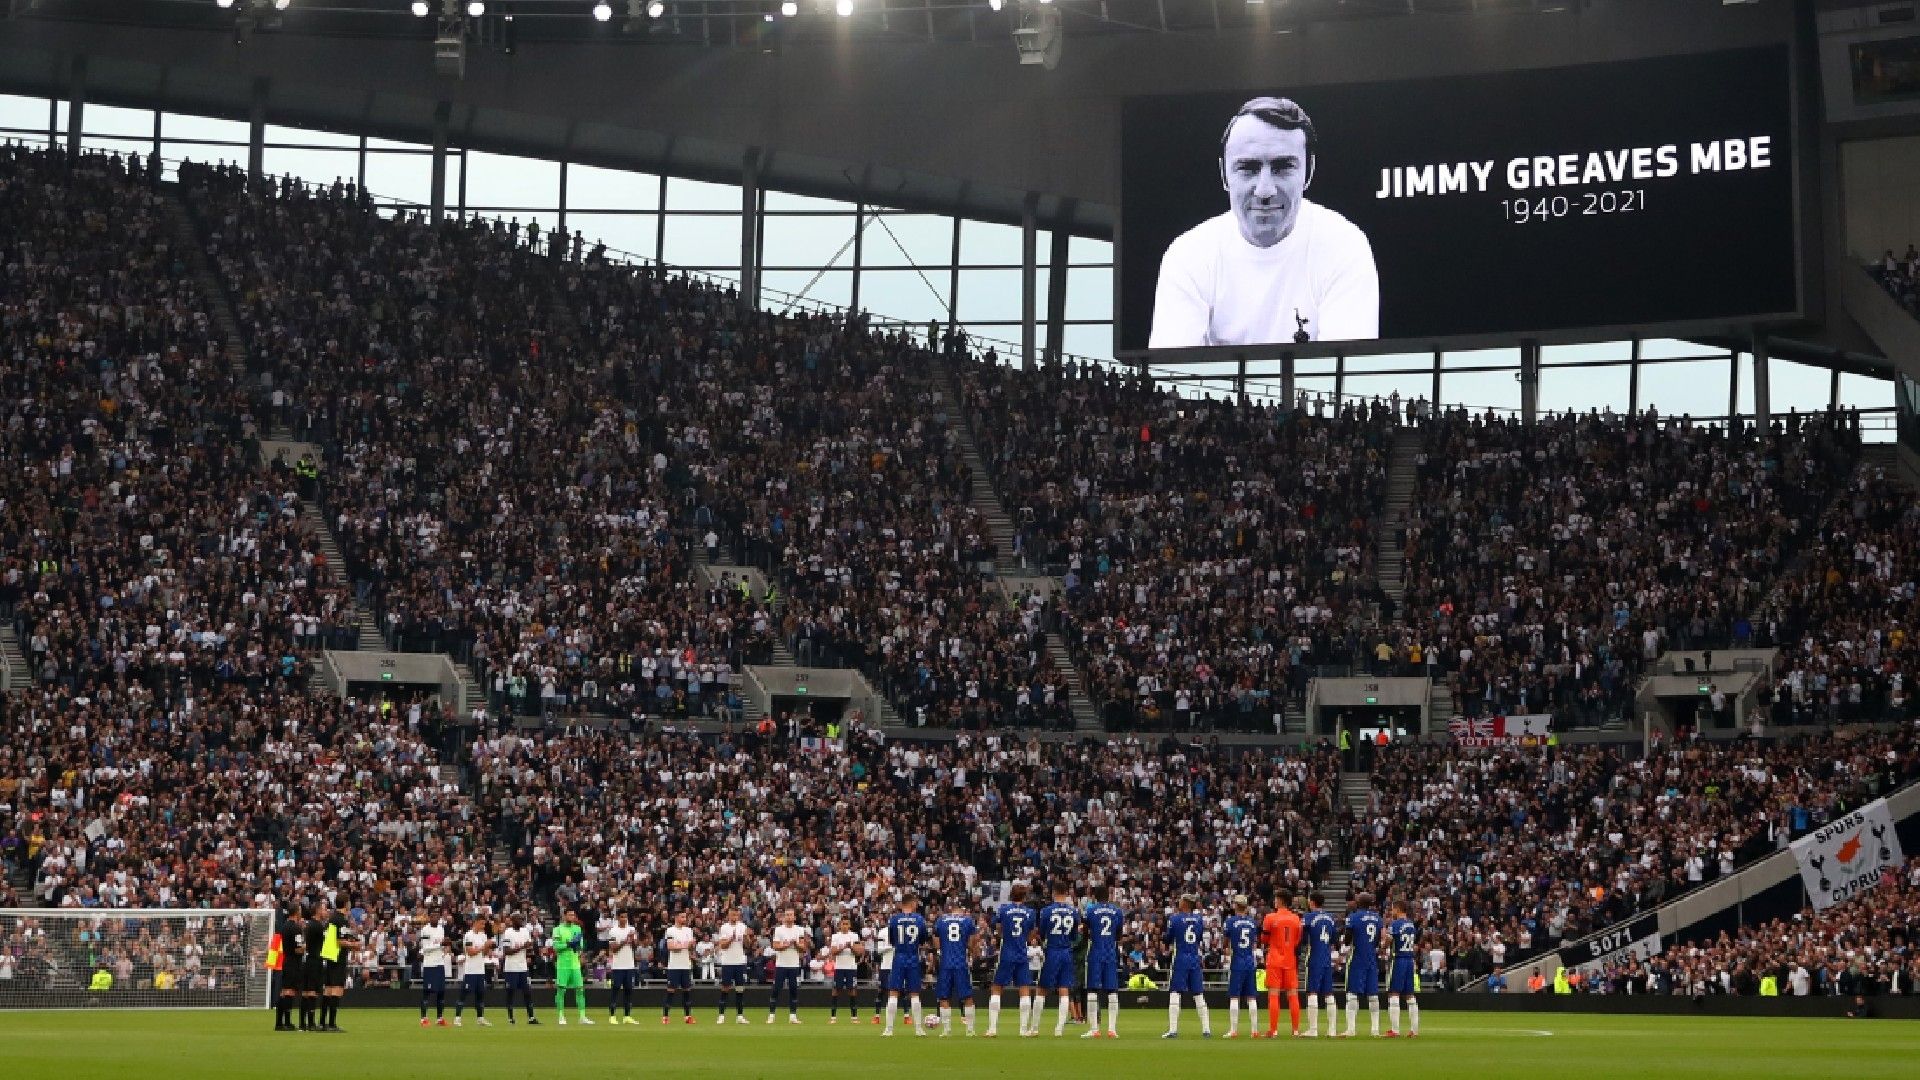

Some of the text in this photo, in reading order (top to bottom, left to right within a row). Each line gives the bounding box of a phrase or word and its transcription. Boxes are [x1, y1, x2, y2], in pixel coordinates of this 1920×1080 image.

[1376, 136, 1771, 198] JIMMY GREAVES MBE
[1501, 190, 1644, 223] 1940-2021
[1815, 811, 1865, 843] SPURS
[897, 924, 919, 945] 19
[948, 922, 961, 942] 8
[1011, 917, 1023, 936] 3
[1050, 914, 1074, 936] 29
[1100, 915, 1111, 936] 2
[1185, 924, 1196, 944] 6
[1319, 924, 1329, 944] 4
[1366, 923, 1376, 943] 9
[1239, 927, 1250, 949] 5
[1589, 927, 1632, 956] 5071
